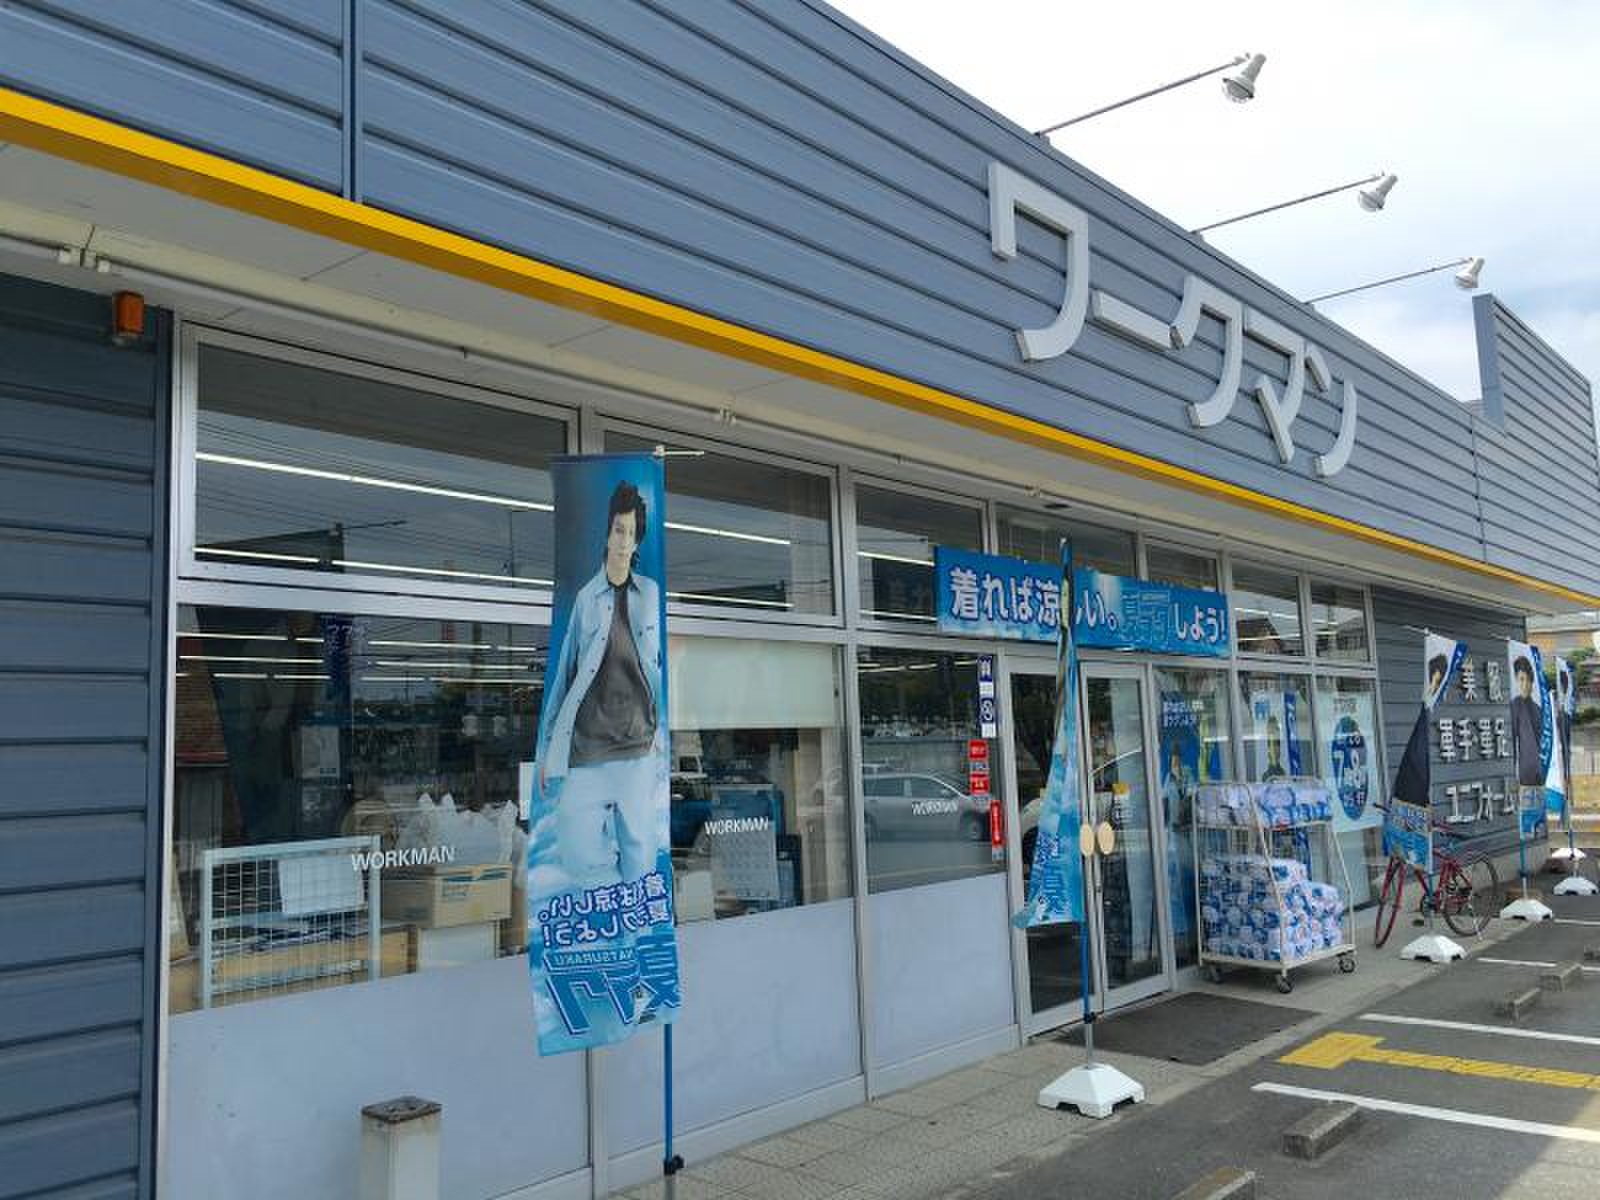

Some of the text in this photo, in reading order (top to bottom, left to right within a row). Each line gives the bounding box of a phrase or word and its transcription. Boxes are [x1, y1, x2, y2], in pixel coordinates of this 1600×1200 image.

[988, 161, 1357, 478] ワークマン
[704, 815, 769, 835] WORKMAN
[351, 845, 456, 872] WORKMAN
